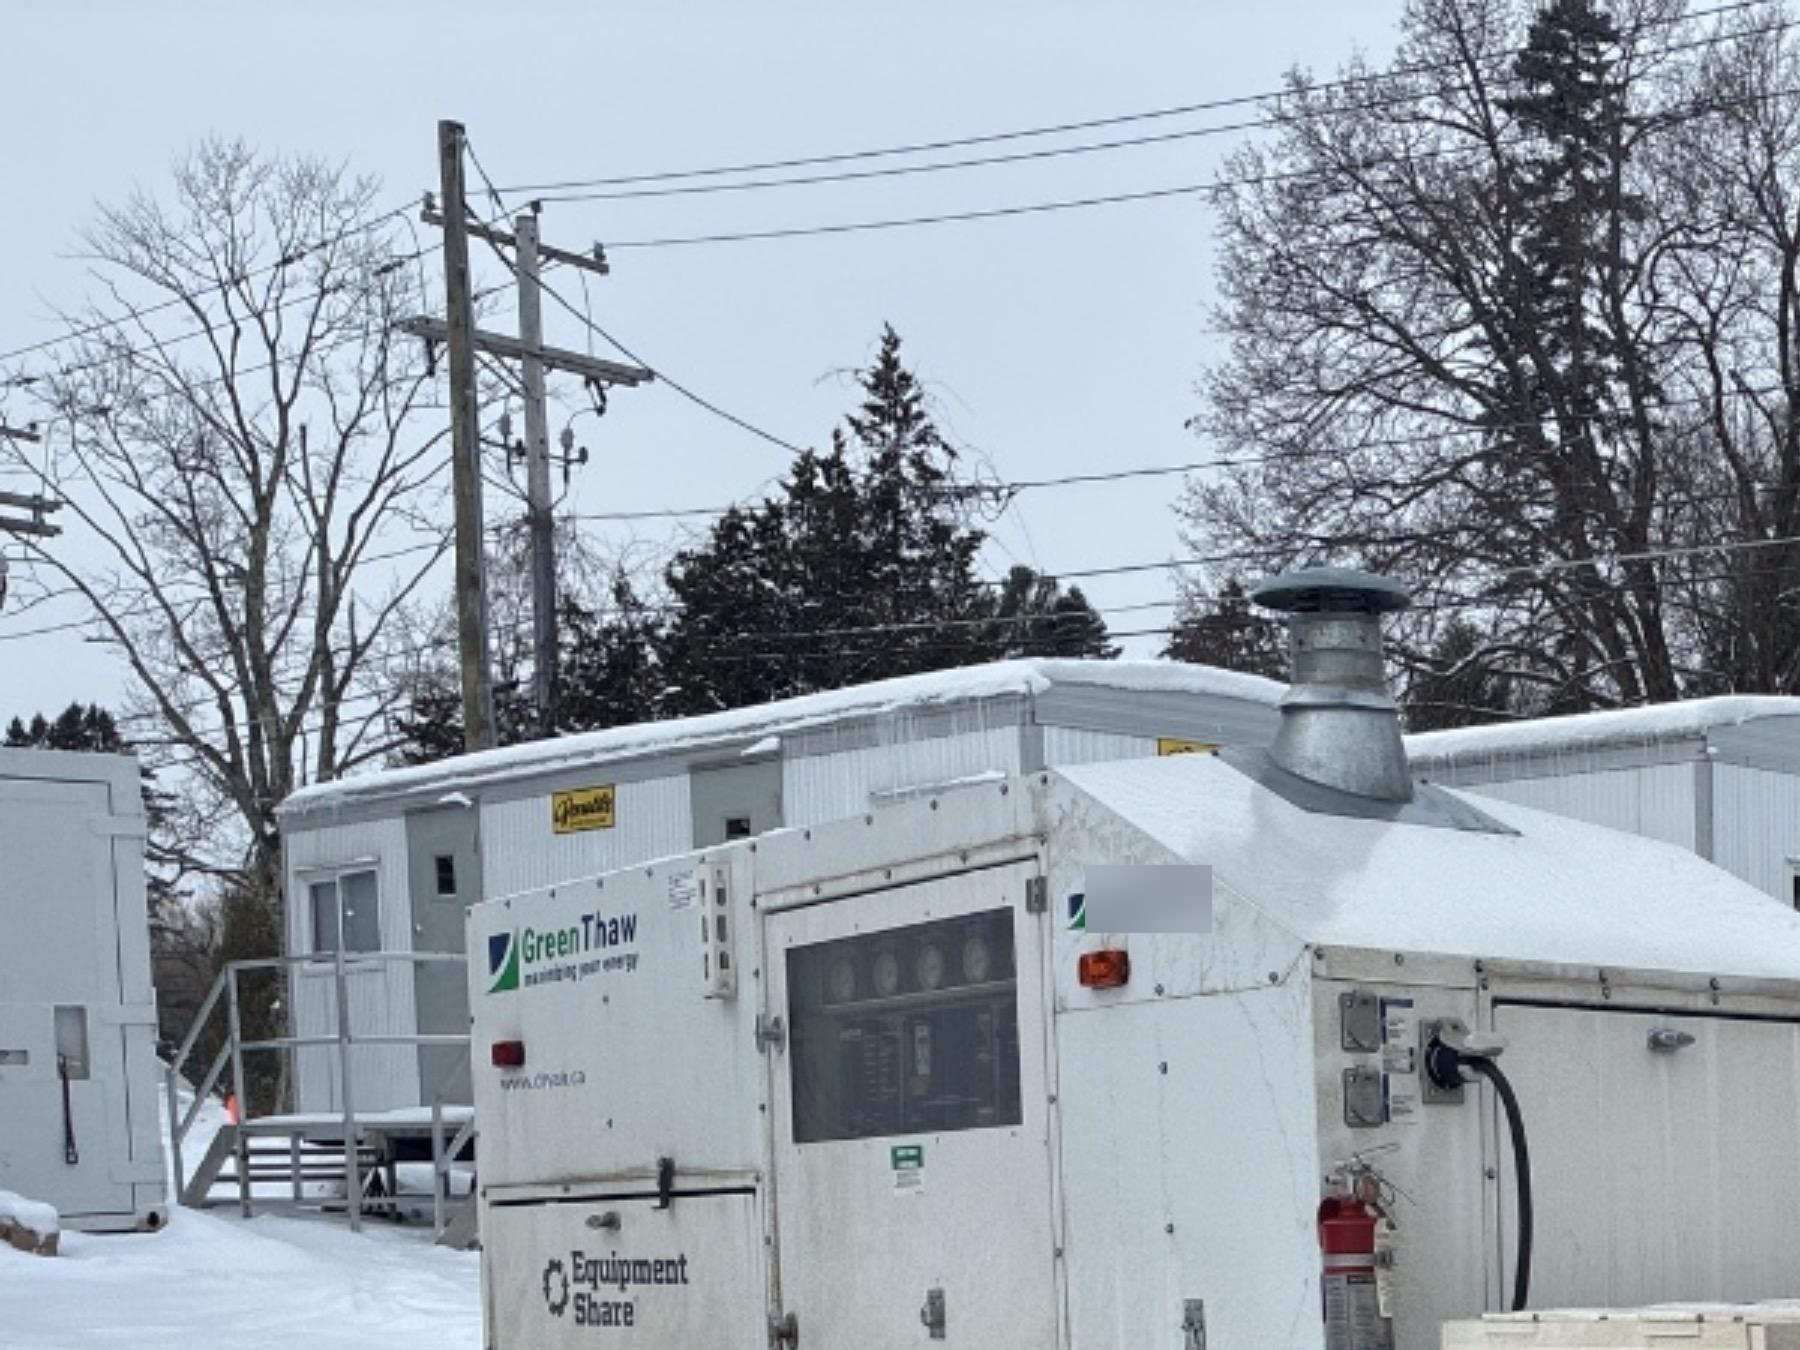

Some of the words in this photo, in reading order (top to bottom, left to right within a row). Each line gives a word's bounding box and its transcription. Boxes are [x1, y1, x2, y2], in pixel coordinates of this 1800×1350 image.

[522, 911, 638, 963] GreenThaw
[571, 1250, 690, 1292] Equipment
[573, 1291, 634, 1327] Share
